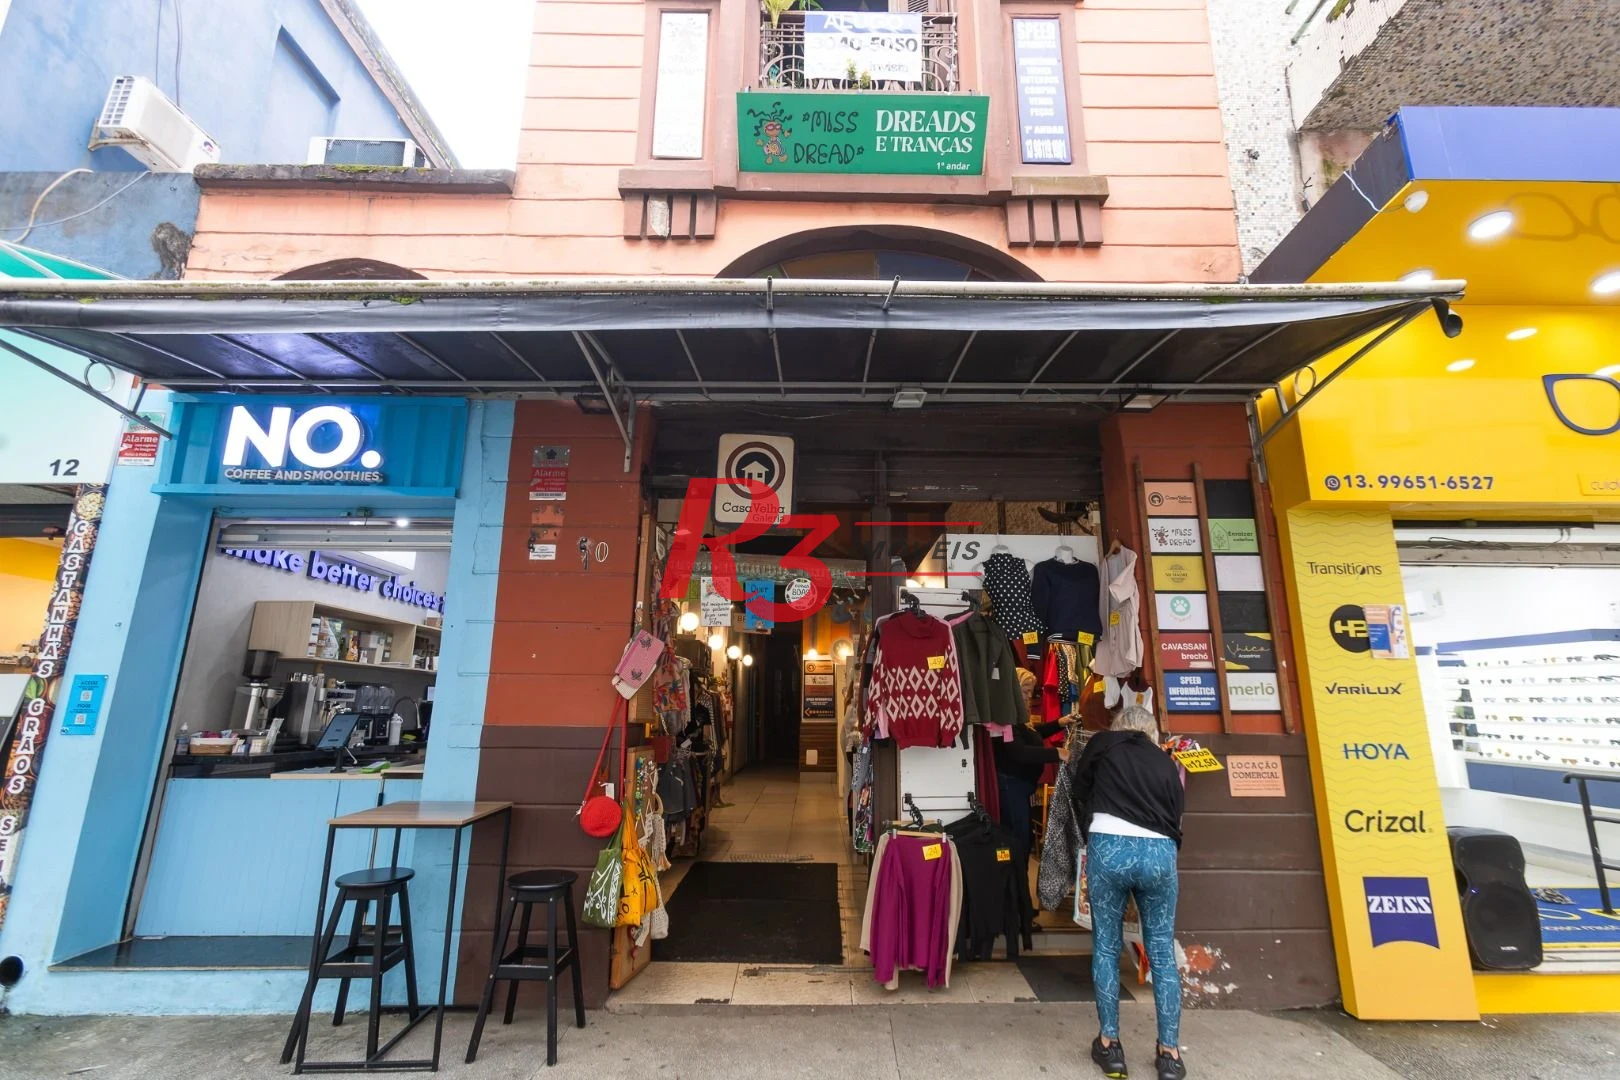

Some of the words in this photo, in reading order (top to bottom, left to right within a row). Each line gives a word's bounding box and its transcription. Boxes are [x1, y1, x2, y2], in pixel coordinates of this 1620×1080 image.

[876, 109, 976, 133] DREADS
[876, 136, 887, 152] E
[891, 136, 973, 156] TRANÇAS
[946, 161, 971, 170] andar
[124, 434, 159, 443] Alarme
[222, 405, 383, 468] NO.
[49, 458, 80, 477] 12
[224, 468, 272, 479] COFFEE
[274, 469, 301, 481] AND
[534, 468, 566, 478] Alarme
[1307, 561, 1383, 576] Transitions
[309, 550, 378, 593] better
[382, 575, 440, 610] choices
[1161, 642, 1208, 651] CAVASSANI
[1181, 652, 1209, 660] brechó
[1179, 675, 1202, 685] SPEED
[1168, 685, 1216, 696] INFORMÁTICA
[1229, 681, 1275, 696] merlô
[7, 698, 46, 795] GRÃOS
[1342, 743, 1410, 760] HOYA
[1177, 751, 1210, 760] LENÇOS
[1231, 761, 1278, 770] LOCAÇÃO
[1232, 771, 1280, 780] COMERCIAL
[1345, 809, 1426, 834] Crizal
[1367, 895, 1432, 915] ZEISS
